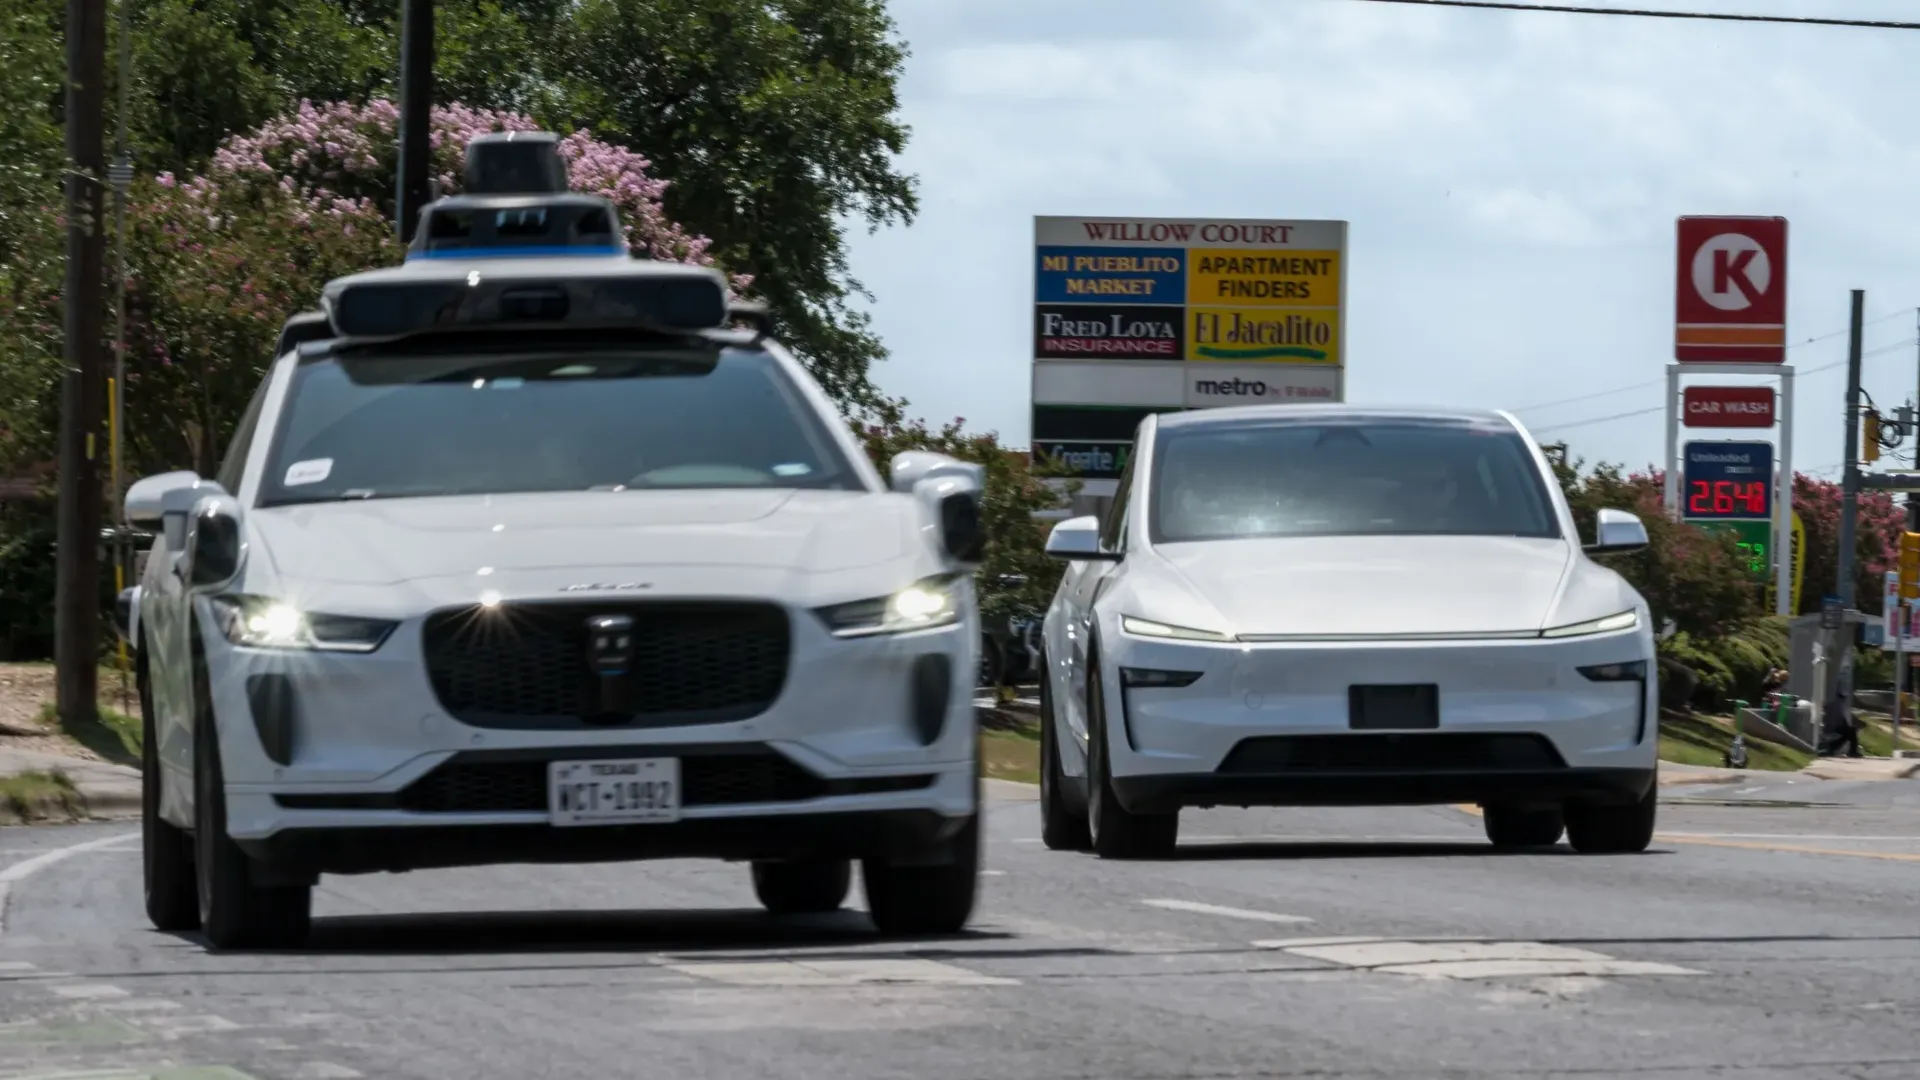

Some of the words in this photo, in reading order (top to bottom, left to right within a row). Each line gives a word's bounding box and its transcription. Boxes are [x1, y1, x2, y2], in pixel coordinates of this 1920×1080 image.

[1083, 222, 1196, 242] WILLOW
[1200, 224, 1294, 244] COURT
[1042, 256, 1068, 272] MI
[1074, 255, 1180, 273] PUEBLITO
[1198, 256, 1332, 276] APARTMENT
[1065, 278, 1157, 295] MARKET
[1711, 248, 1766, 308] K
[1217, 279, 1310, 299] FINDERS
[1194, 311, 1219, 344] El
[1227, 312, 1331, 346] Jacalito
[1044, 339, 1173, 353] INSURANCE
[1195, 376, 1266, 397] metro
[1688, 402, 1721, 414] CAR
[1725, 402, 1770, 414] WASH
